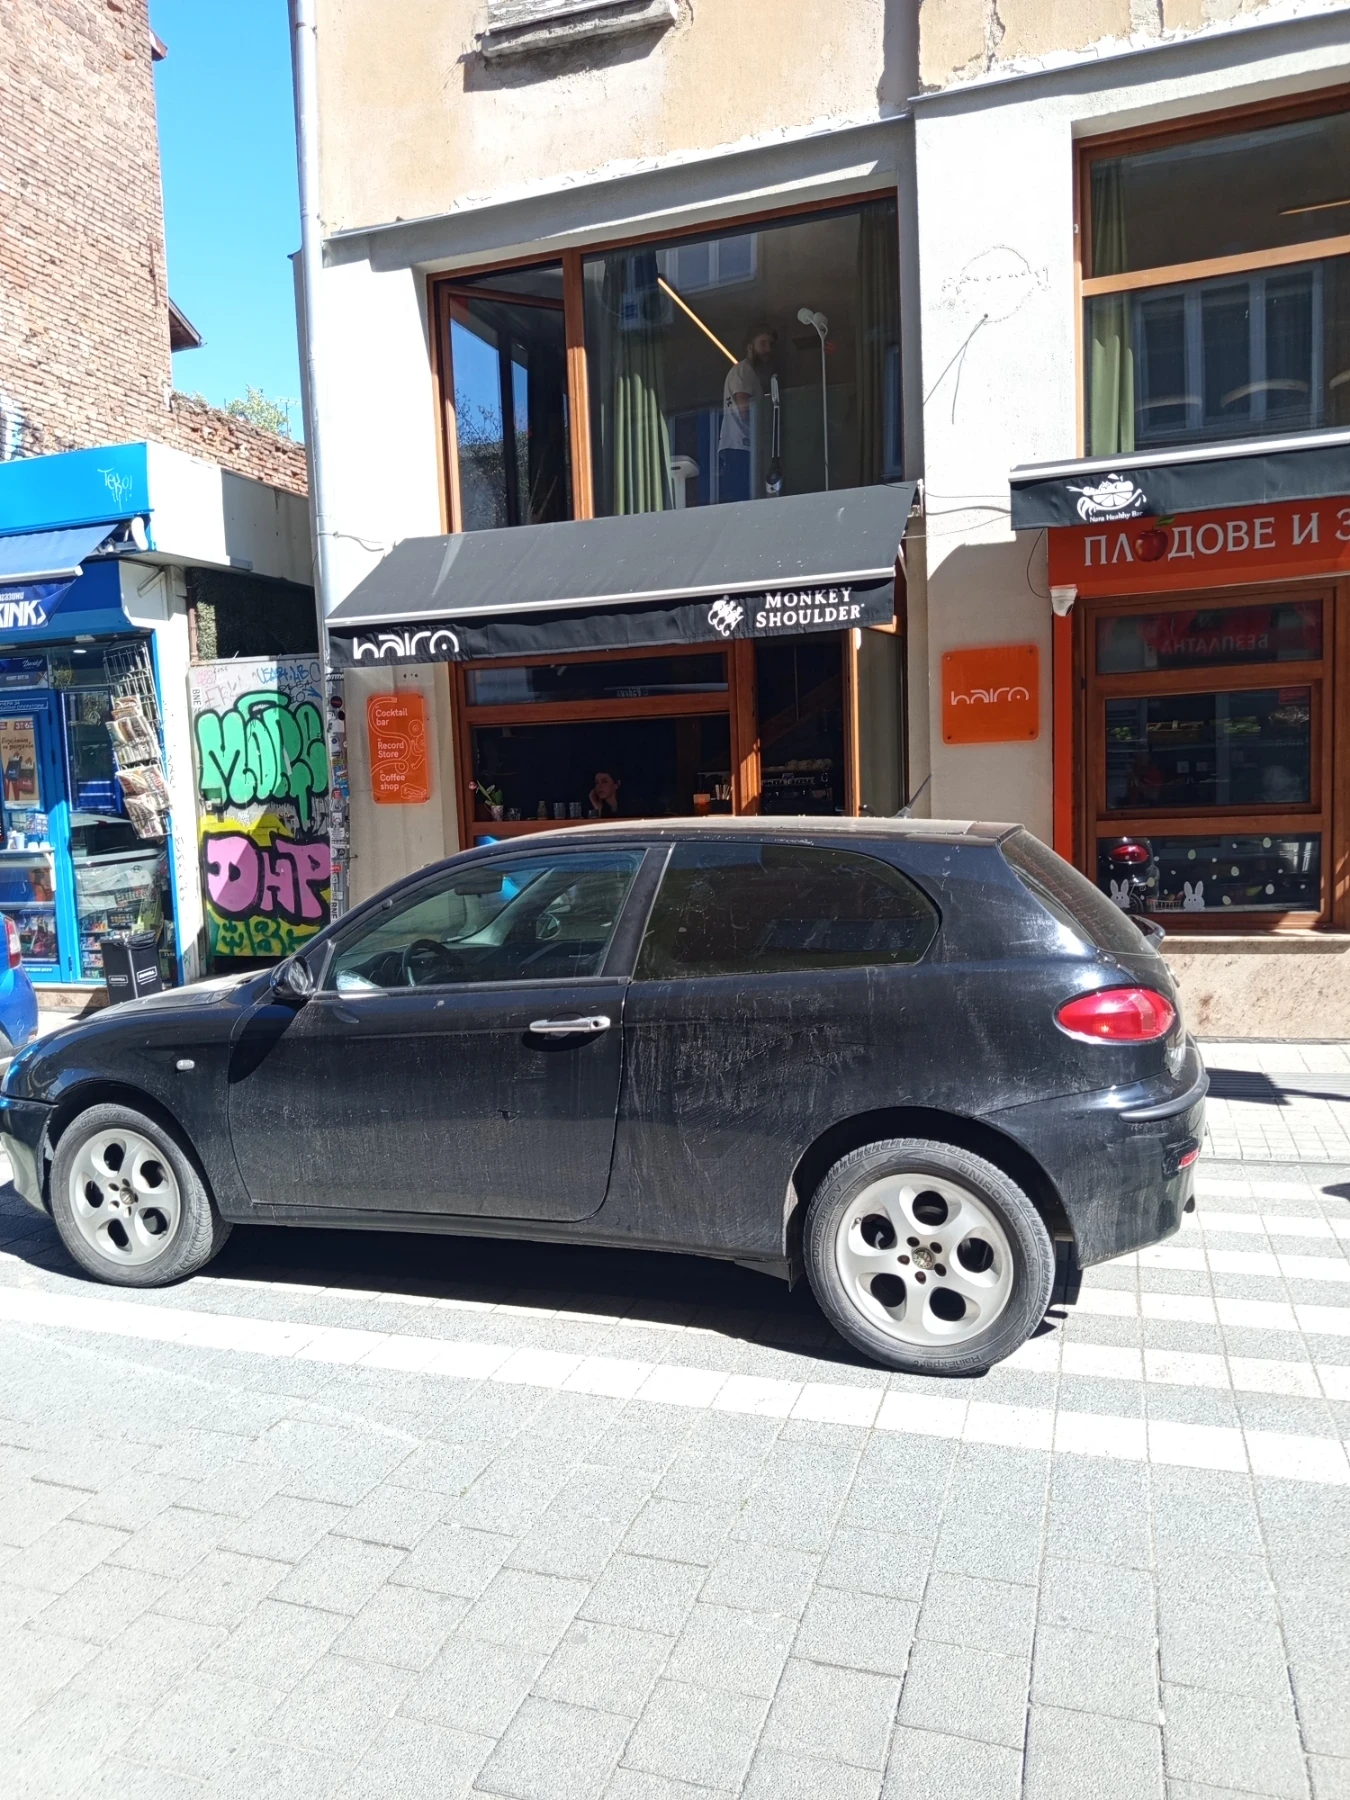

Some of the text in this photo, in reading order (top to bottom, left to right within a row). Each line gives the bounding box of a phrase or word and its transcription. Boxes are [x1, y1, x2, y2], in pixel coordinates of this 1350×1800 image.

[1106, 511, 1131, 521] Healthy
[1291, 512, 1319, 546] И
[765, 587, 852, 609] MONKEY
[755, 604, 865, 628] SHOULDER
[192, 688, 202, 706] BNE
[375, 708, 408, 718] Cocktail
[376, 718, 390, 726] bar
[377, 740, 405, 750] Record
[378, 750, 399, 758] Store
[380, 773, 405, 782] Coffee
[380, 783, 399, 792] shop
[958, 1162, 1019, 1227] UNIROYAL
[812, 1184, 842, 1265] 205/55 R 16 V
